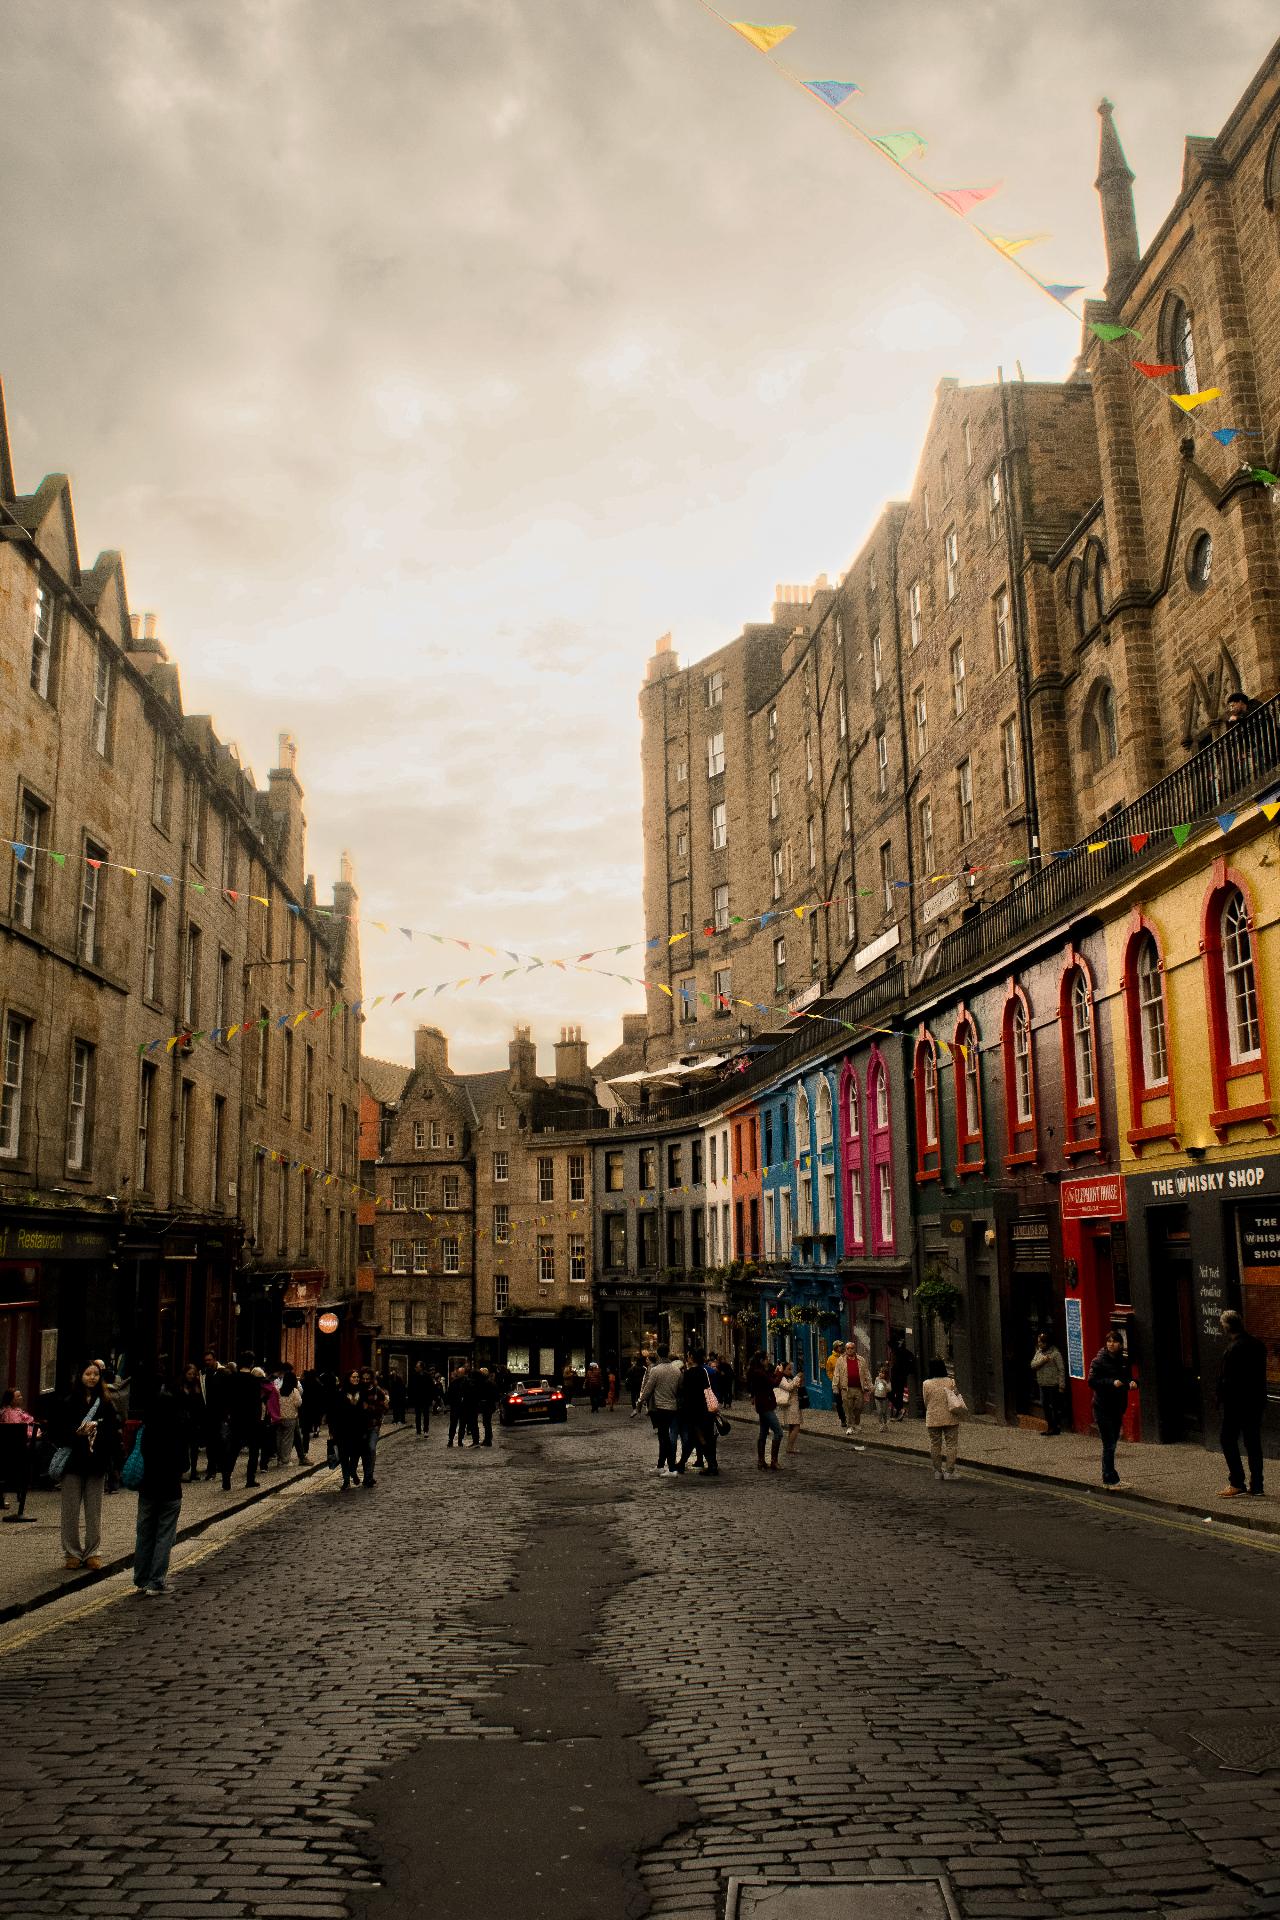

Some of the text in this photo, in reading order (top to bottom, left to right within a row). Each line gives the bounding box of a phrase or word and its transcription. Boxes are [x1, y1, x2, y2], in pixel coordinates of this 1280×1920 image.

[1151, 1167, 1265, 1197] THE WHISKY SHOP
[1101, 1184, 1118, 1201] HOUSE
[1254, 1218, 1278, 1227] THE
[18, 1228, 64, 1248] Restaurant
